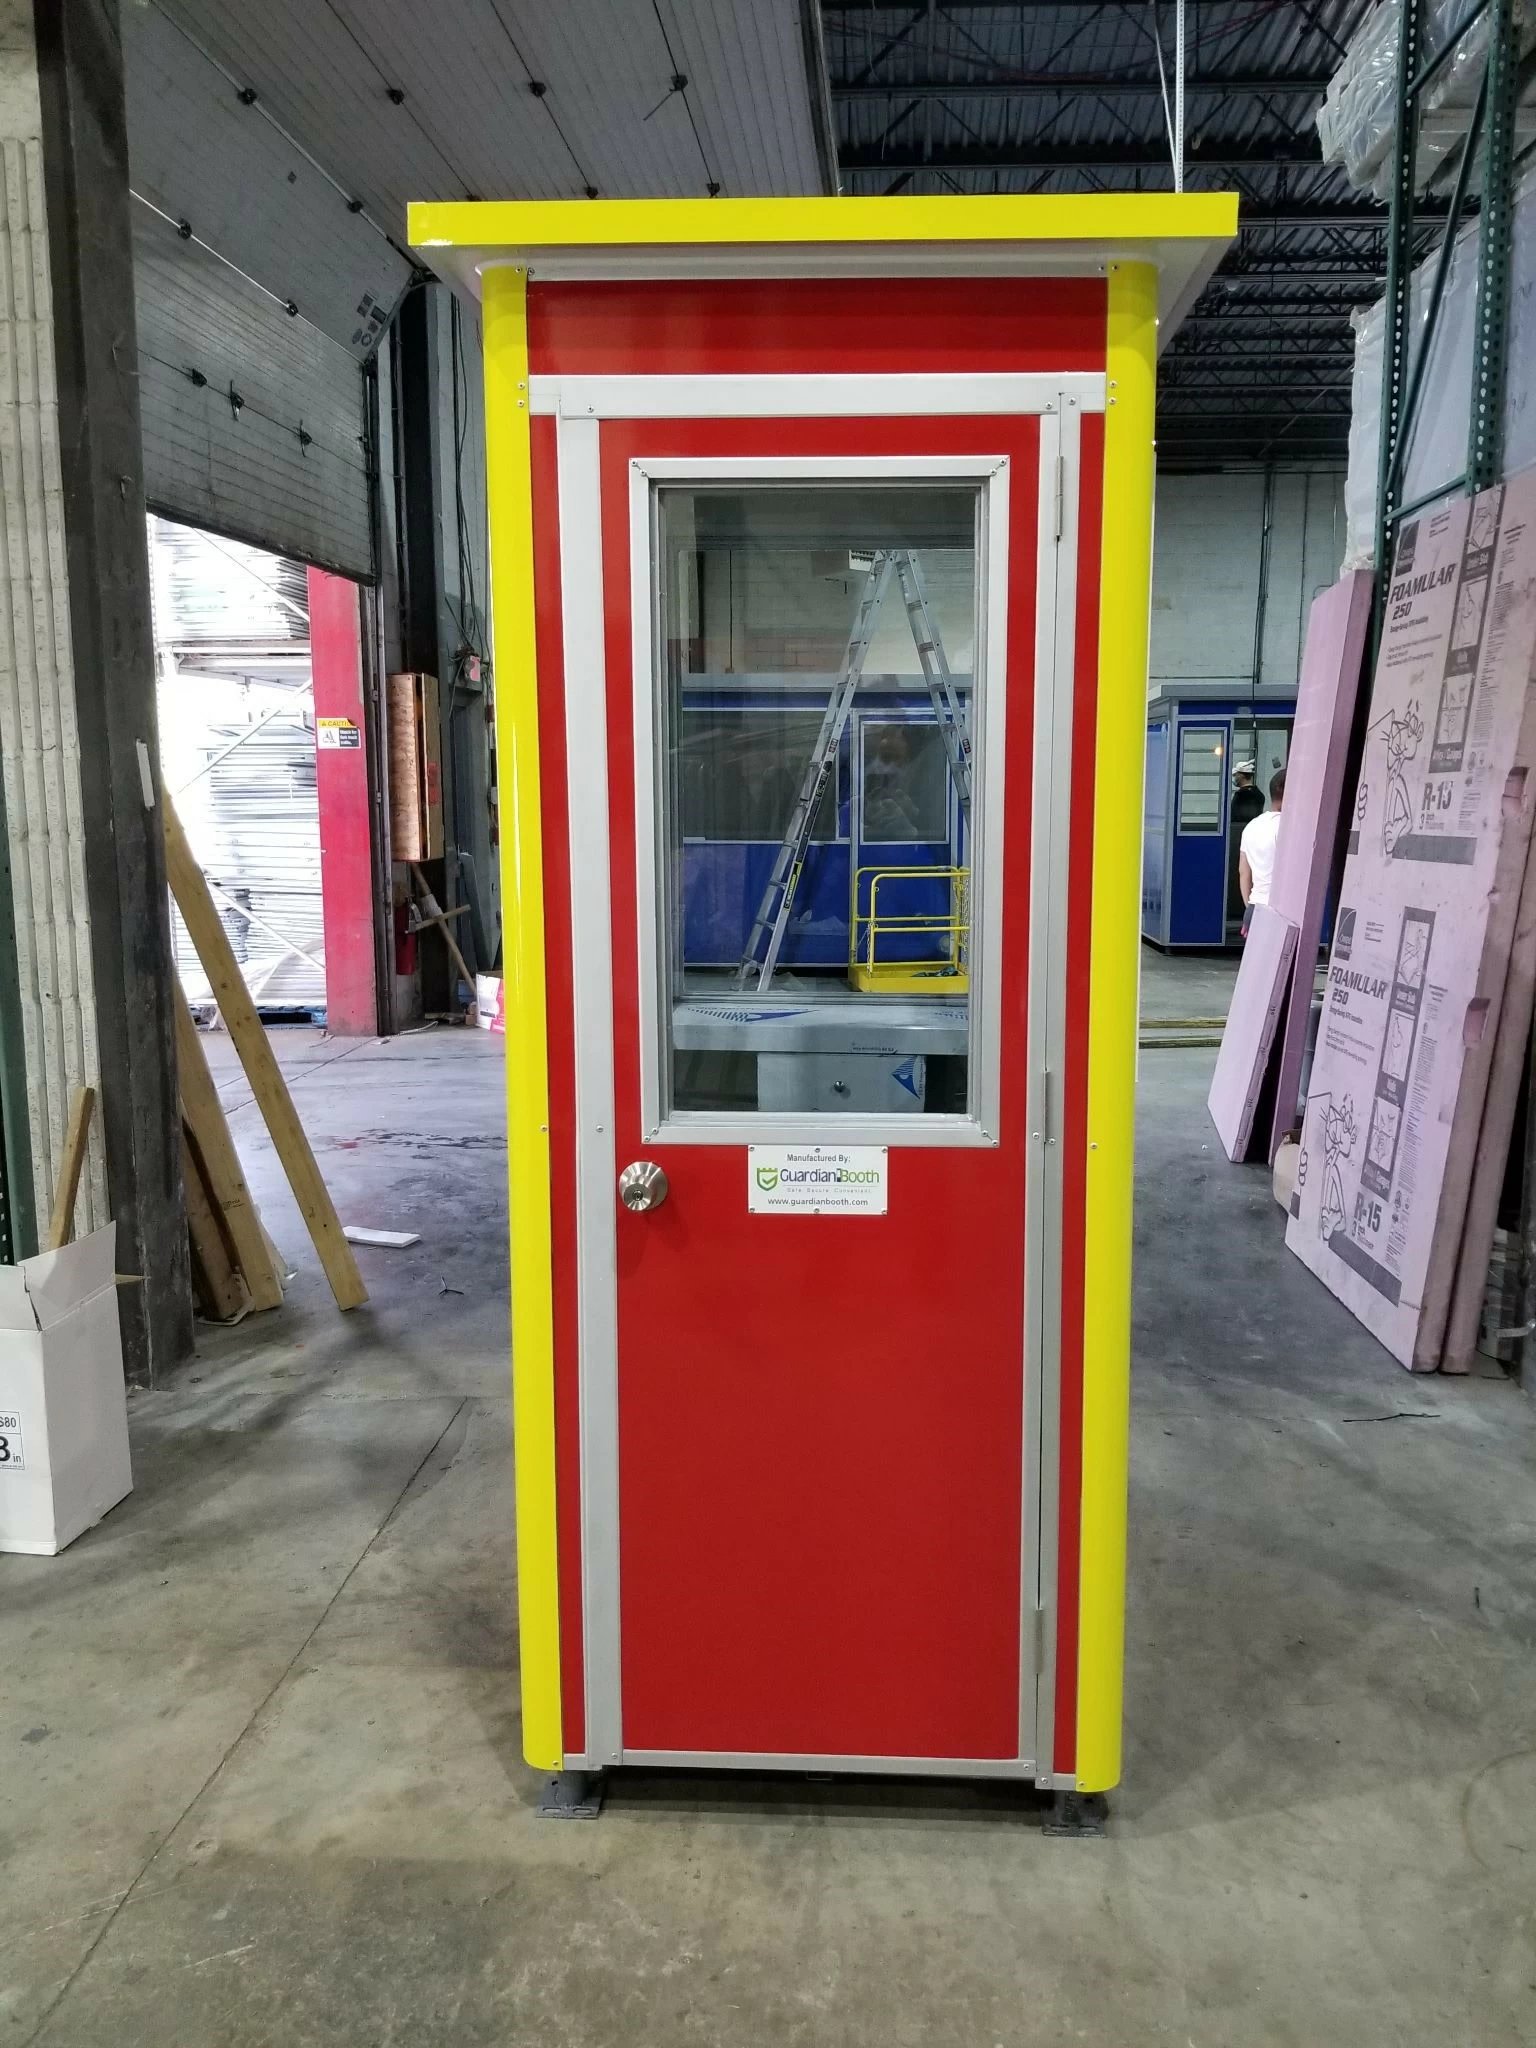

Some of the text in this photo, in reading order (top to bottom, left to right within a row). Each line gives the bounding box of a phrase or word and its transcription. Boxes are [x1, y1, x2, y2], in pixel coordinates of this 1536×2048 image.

[1389, 563, 1457, 604] FOAMULAR
[1392, 601, 1413, 621] 250
[1329, 965, 1388, 1000] FOAMULAR
[1331, 987, 1349, 1005] 250
[787, 1154, 837, 1162] Manufactured
[767, 1197, 869, 1207] www.guardianbooth.com
[1353, 1190, 1382, 1233] R-15
[12, 1453, 21, 1463] in
